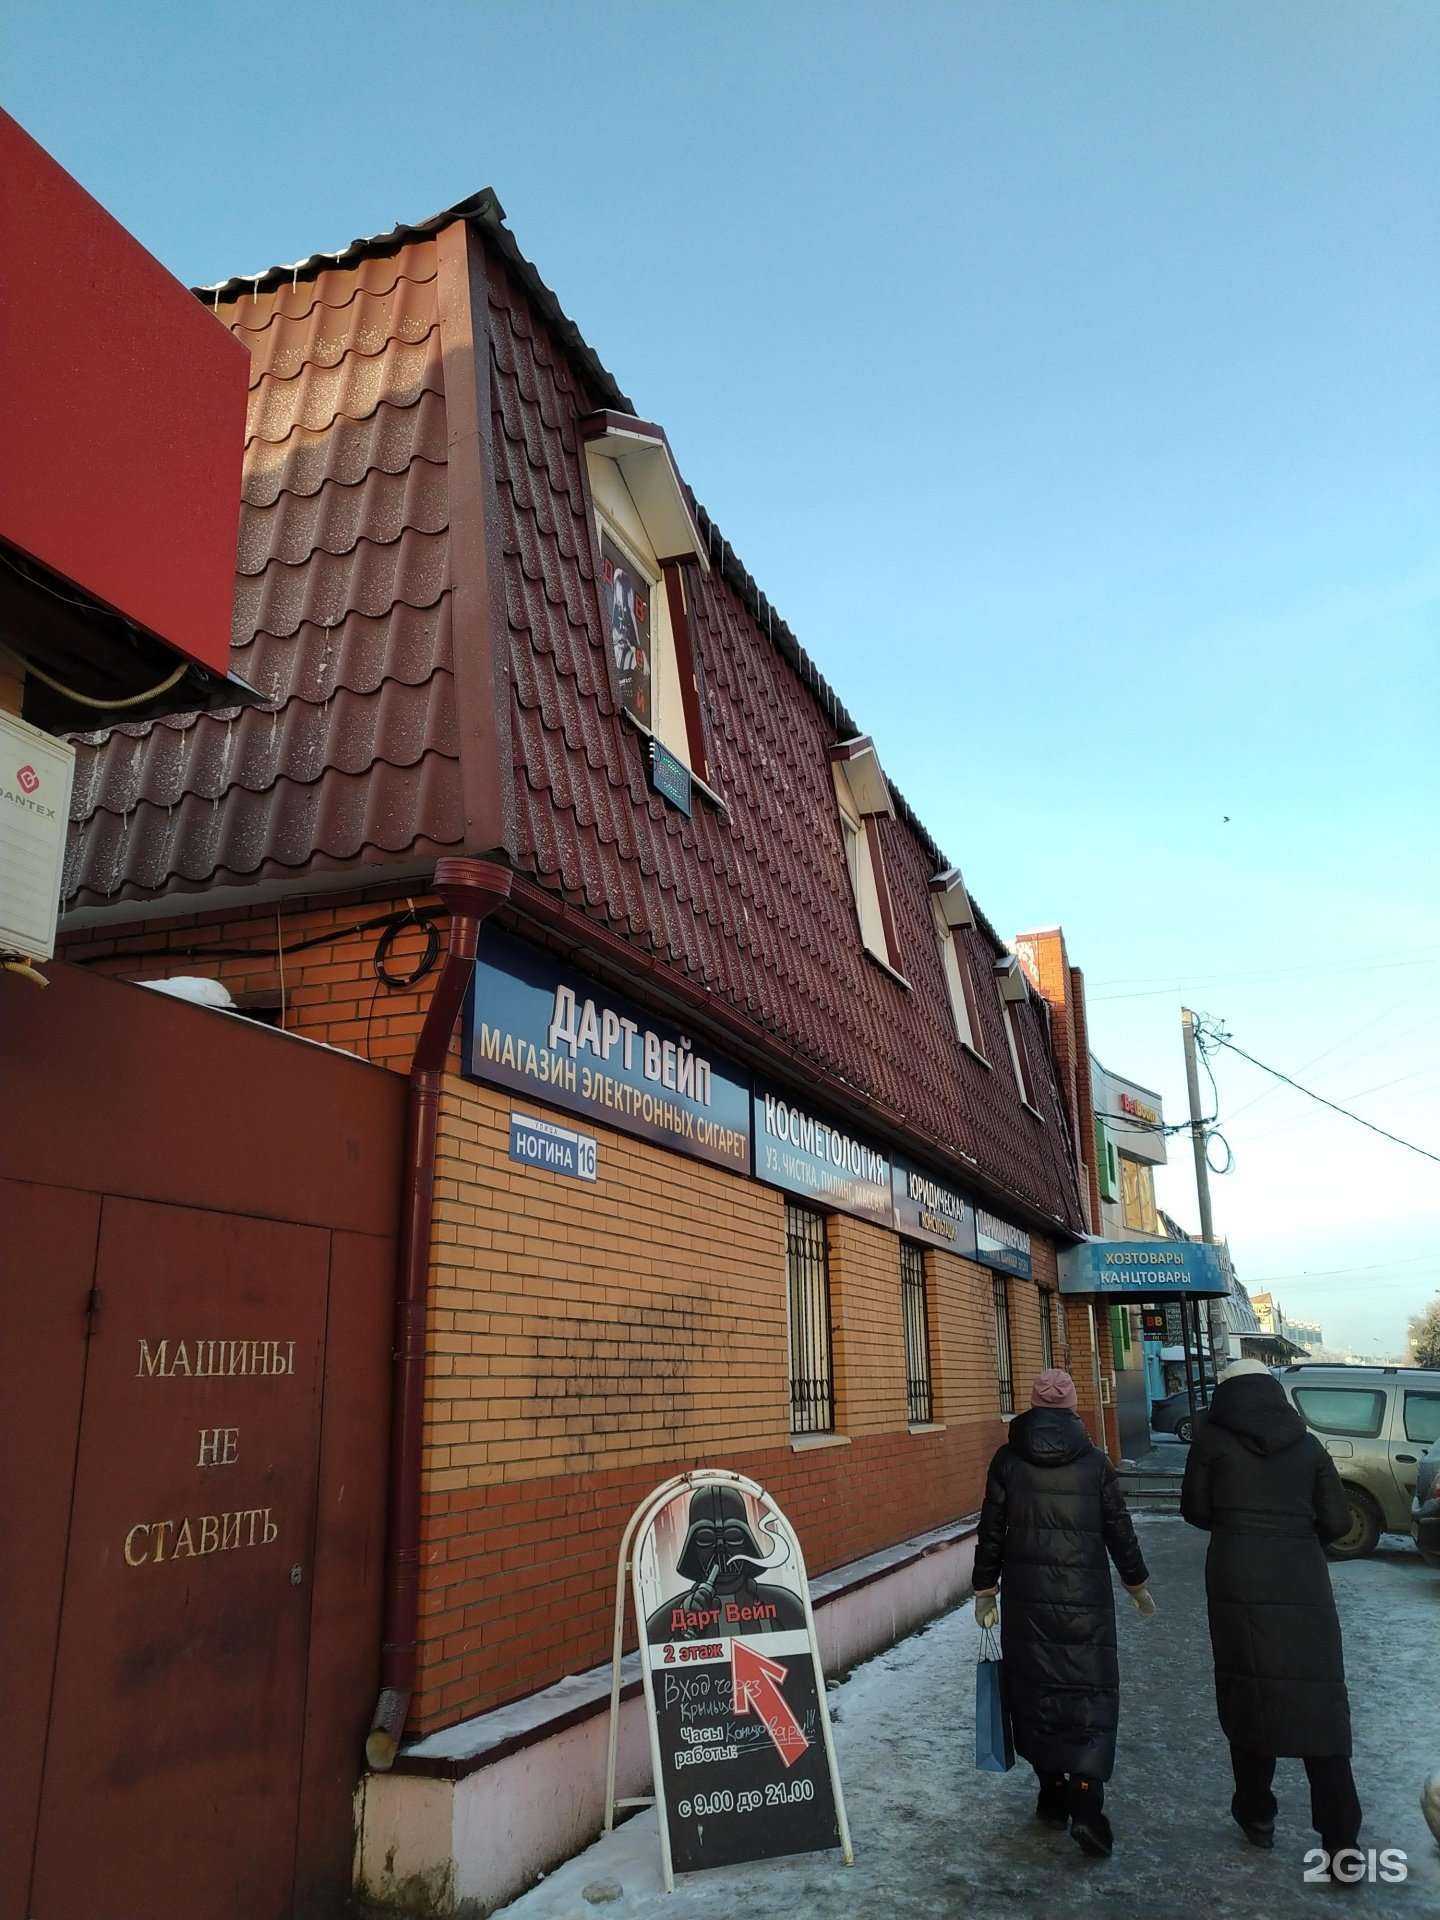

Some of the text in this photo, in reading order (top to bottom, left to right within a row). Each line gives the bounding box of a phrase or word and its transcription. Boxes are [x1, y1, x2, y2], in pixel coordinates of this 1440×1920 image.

[549, 984, 711, 1106] ДАРТ ВЕЙП
[480, 1023, 747, 1160] МАГАЗИН ЭЛЕКТРОННЫХ СИГАРЕТ
[516, 1132, 596, 1175] НОГИНА 16
[764, 1092, 885, 1186] КОСМЕТОЛОГИЯ
[909, 1171, 965, 1221] ЮРИДИЧЕСКАЯ
[1100, 1271, 1192, 1285] КАНЦТОВАРЫ
[1105, 1252, 1185, 1266] ХОЗТОВАРЫ
[136, 1339, 296, 1377] МАШИНЫ
[196, 1427, 240, 1467] НЕ
[124, 1508, 278, 1566] СТАВИТЬ
[671, 1601, 777, 1632] Дарт Вейп
[664, 1643, 724, 1664] 2 этаж
[664, 1672, 762, 1711] Вход через
[680, 1726, 724, 1744] Часы
[674, 1744, 738, 1770] работы:
[678, 1779, 815, 1818] с 9.00 до 21.00
